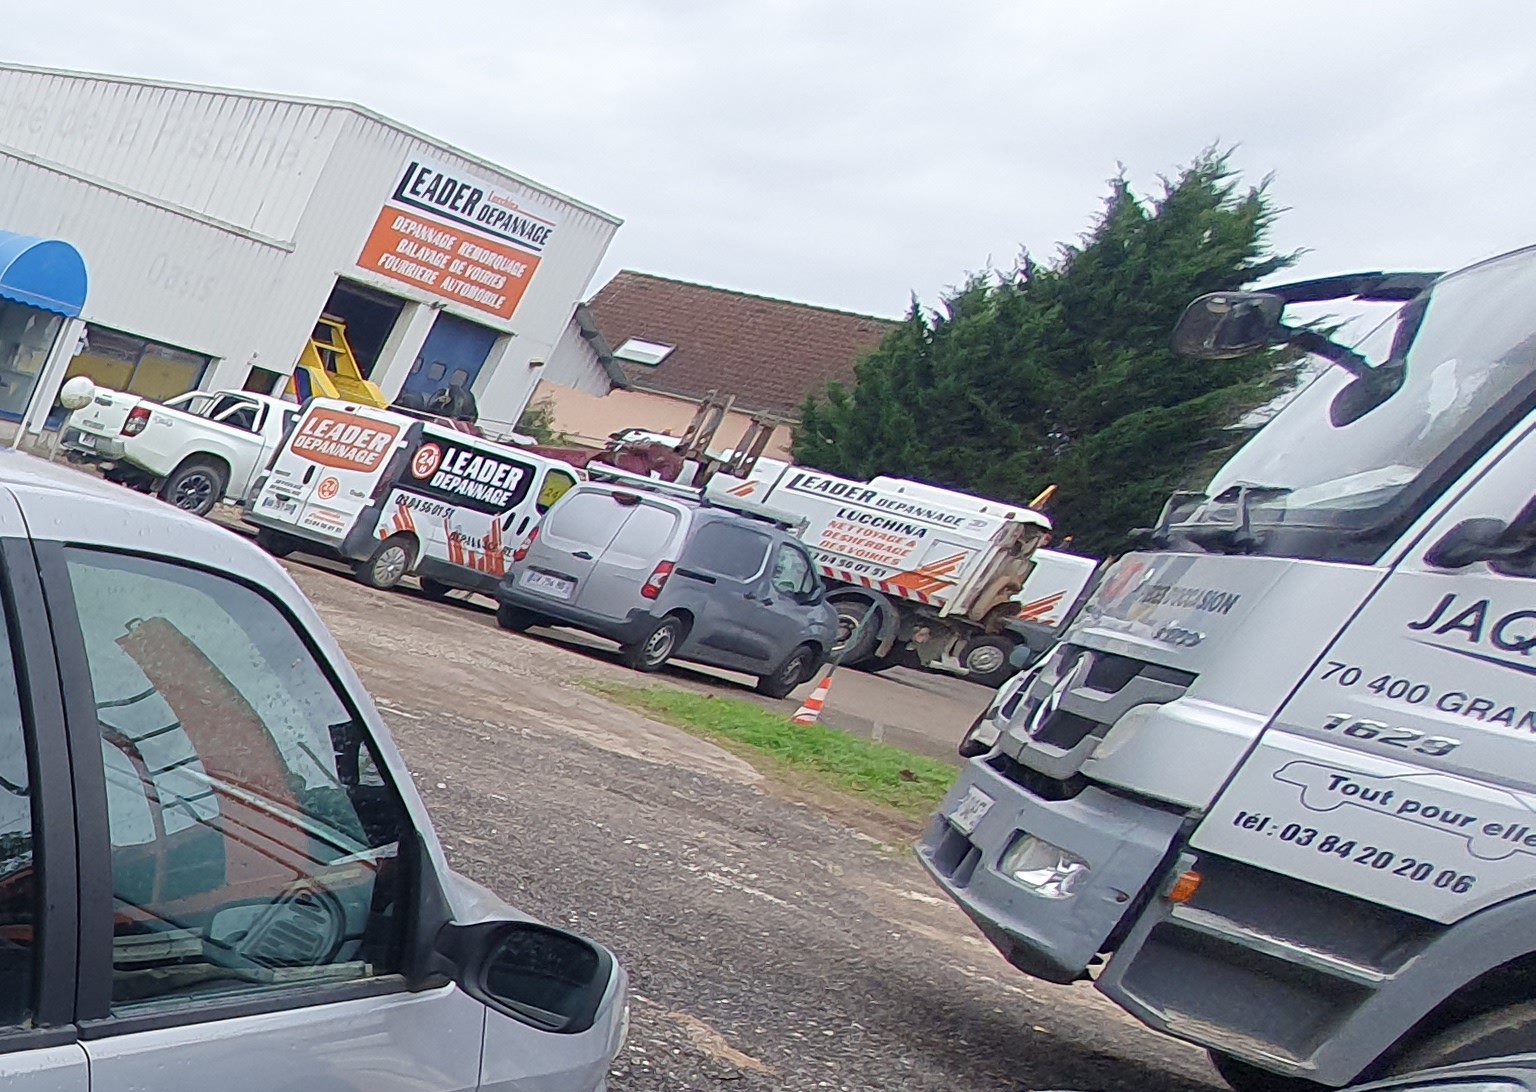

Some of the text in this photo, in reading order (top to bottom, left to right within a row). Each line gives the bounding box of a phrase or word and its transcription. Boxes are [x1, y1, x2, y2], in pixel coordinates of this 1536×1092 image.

[391, 161, 483, 217] LEADER
[478, 204, 553, 246] DEPANNAGE
[391, 215, 528, 278] DEPANNAGE REMORQUAGE
[396, 238, 452, 270] BALAYAGE
[448, 259, 468, 275] DE
[378, 253, 507, 309] FOURRIERE AUTOMOBILE
[293, 435, 378, 466] DEPANNAGE
[302, 416, 392, 453] LEADER
[418, 451, 435, 465] 24
[440, 447, 524, 492] LEADER
[430, 471, 512, 508] DEPANNAGE
[786, 473, 877, 502] LEADER
[836, 508, 928, 538] LUCCHINA
[876, 498, 966, 526] DEPANNAGE
[819, 540, 847, 552] DES
[822, 529, 913, 557] DESHERBAGE
[829, 520, 908, 546] NETTOYAGE
[1320, 661, 1362, 686] 70
[1367, 675, 1431, 704] 400
[1327, 774, 1395, 806] Tout
[1396, 798, 1478, 827] pour
[1279, 823, 1318, 847] 03
[1317, 835, 1358, 859] 84
[1353, 846, 1396, 870] 20
[1392, 857, 1434, 881] 20
[1433, 869, 1477, 894] 06
